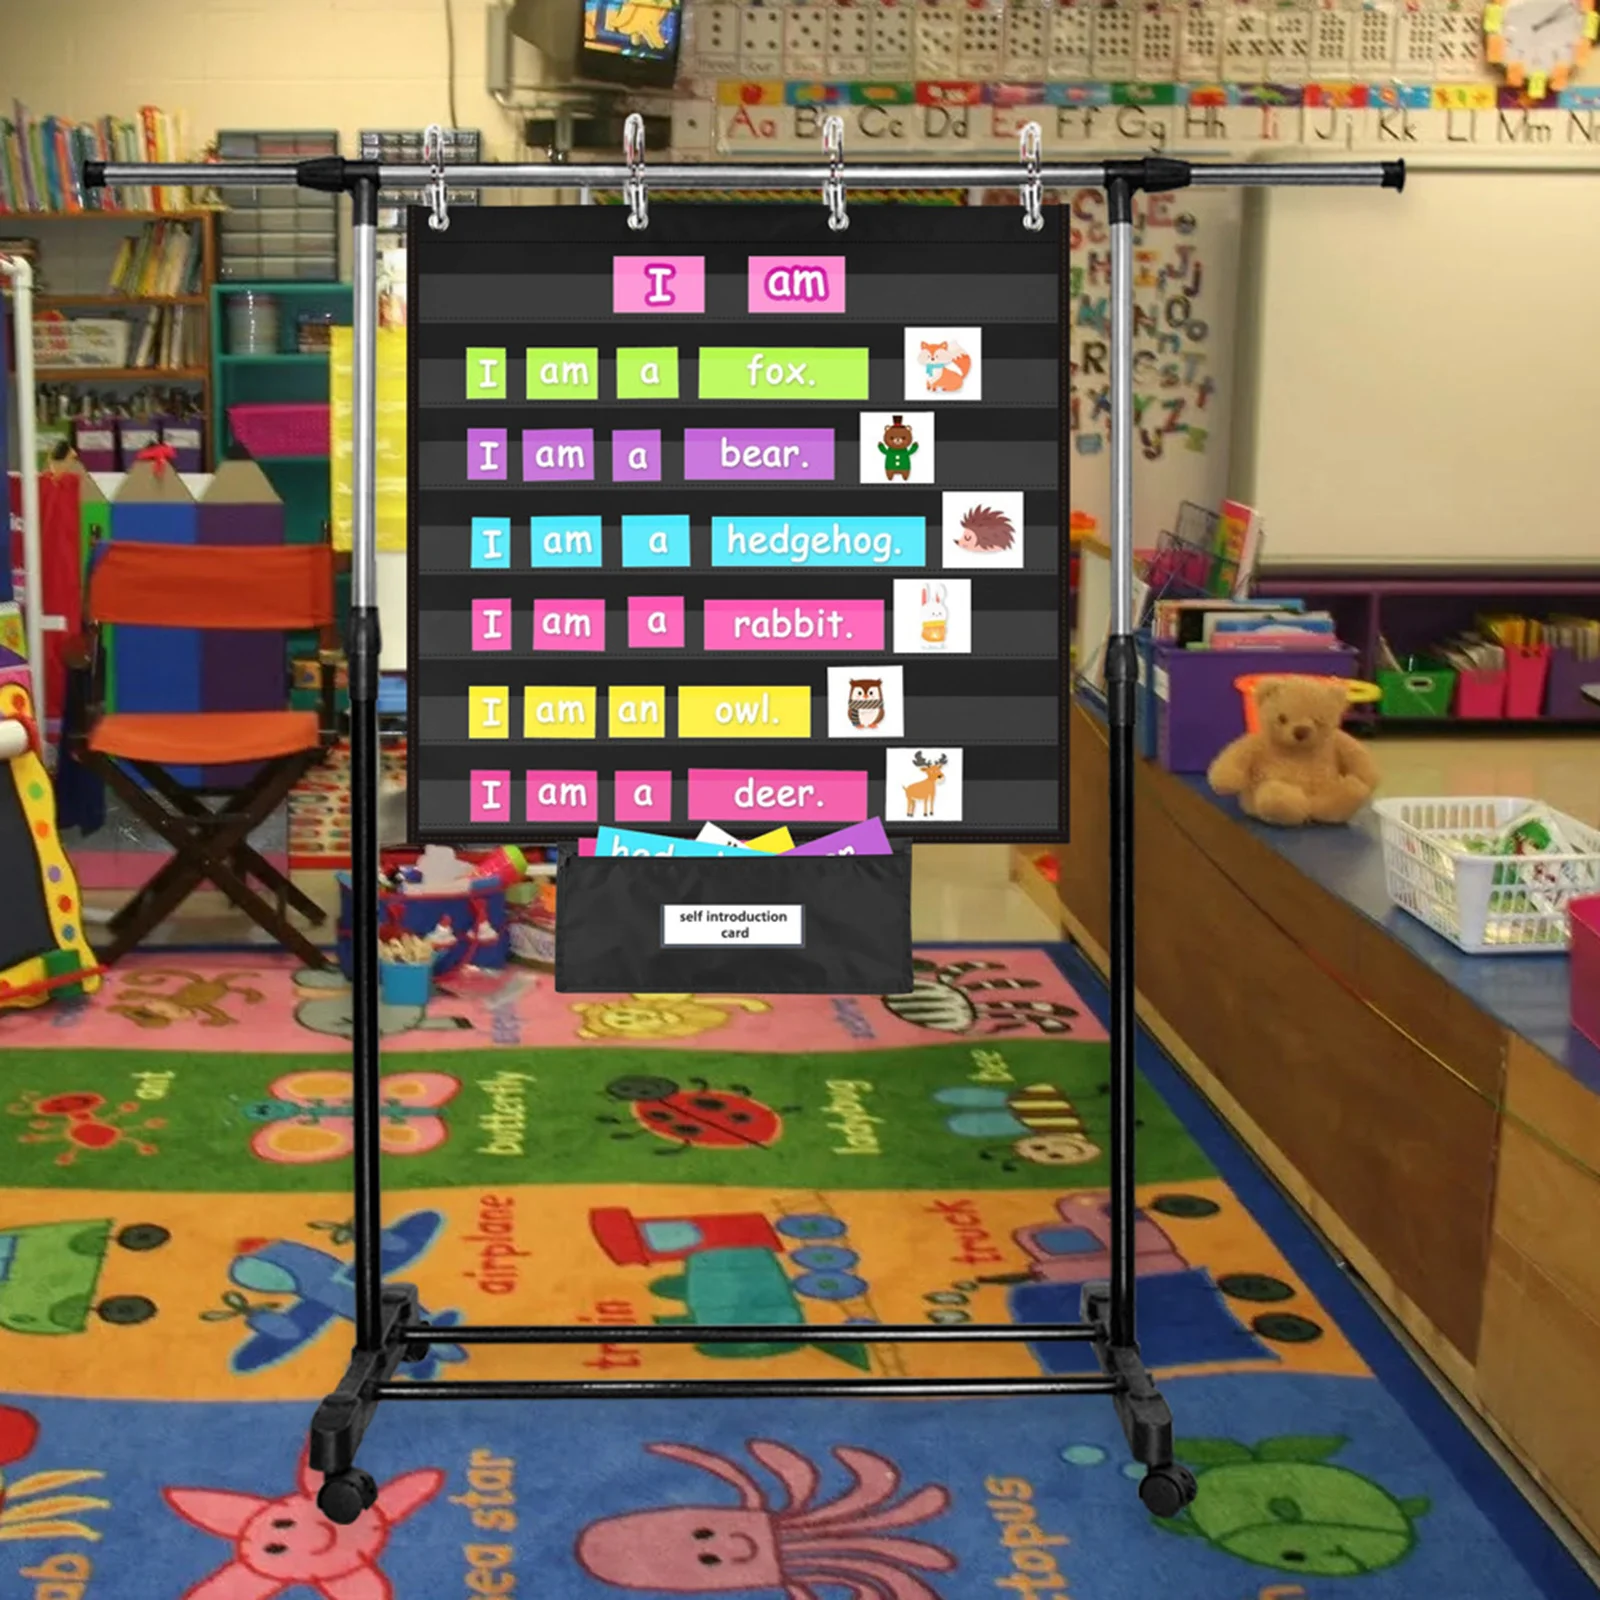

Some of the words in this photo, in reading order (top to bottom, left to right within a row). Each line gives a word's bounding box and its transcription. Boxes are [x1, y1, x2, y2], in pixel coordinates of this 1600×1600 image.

[727, 103, 778, 139] Aa
[794, 104, 826, 139] B
[858, 104, 904, 139] Cc
[924, 103, 968, 139] Dd
[1056, 103, 1101, 139] Ff
[1116, 103, 1166, 154] Gg
[1184, 103, 1227, 139] Hh
[1312, 107, 1354, 151] Jj
[1376, 107, 1418, 142] Kk
[1446, 107, 1476, 142] Ll
[1497, 107, 1551, 142] Mm
[1072, 188, 1105, 221] C
[1146, 193, 1176, 228] E
[644, 263, 676, 307] I
[764, 265, 830, 302] am
[1166, 295, 1191, 329] O
[479, 358, 498, 388] I
[539, 361, 589, 385] am
[640, 362, 660, 385] a
[746, 353, 815, 386] fox.
[1082, 341, 1107, 374] R
[479, 441, 500, 471] I
[535, 444, 585, 469] am
[628, 447, 648, 470] a
[721, 436, 809, 469] bear.
[482, 529, 503, 560] I
[543, 530, 593, 554] am
[648, 531, 668, 554] a
[727, 523, 902, 563] hedgehog.
[483, 609, 503, 640] I
[542, 612, 591, 637] am
[647, 611, 667, 634] a
[734, 607, 853, 639] rabbit.
[482, 697, 502, 727] I
[536, 700, 586, 724] am
[617, 700, 658, 723] an
[715, 692, 780, 724] owl.
[481, 780, 502, 810] I
[537, 783, 587, 807] am
[633, 784, 653, 807] a
[734, 776, 825, 808] deer.
[680, 911, 703, 922] self
[706, 911, 787, 922] introduction
[721, 928, 749, 938] card
[966, 1049, 1016, 1082] bee
[131, 1071, 176, 1100] ant
[475, 1069, 537, 1155] butterfly
[820, 1079, 885, 1155] ladybug
[460, 1193, 532, 1295] airplane
[922, 1198, 1004, 1265] truck
[577, 1300, 642, 1370] trin
[447, 1448, 517, 1532] star
[984, 1474, 1072, 1600] topus
[464, 1543, 516, 1600] ea
